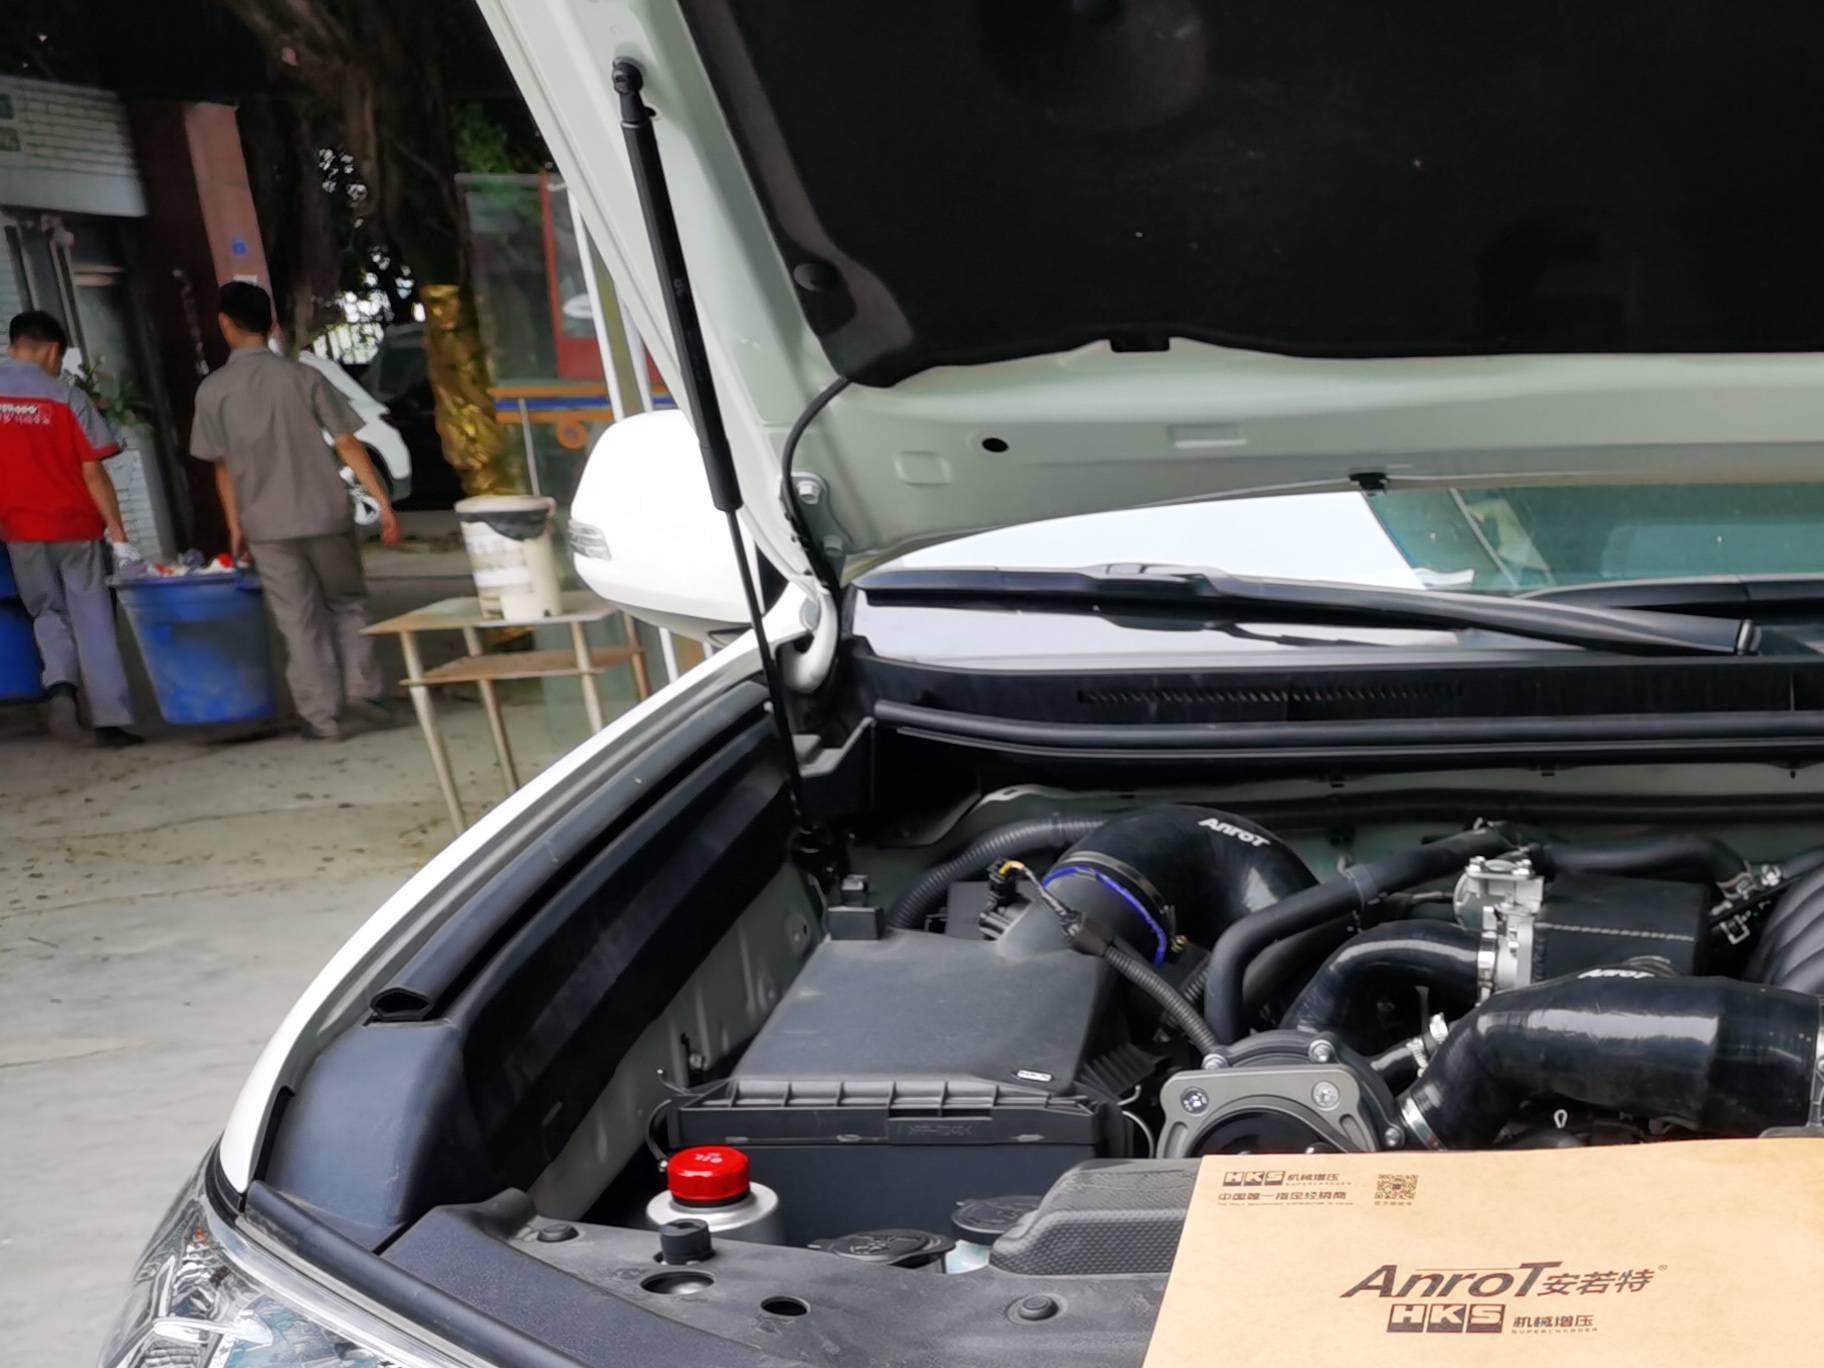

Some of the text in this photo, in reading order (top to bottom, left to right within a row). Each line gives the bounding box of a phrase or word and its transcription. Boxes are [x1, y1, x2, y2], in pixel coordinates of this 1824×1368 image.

[1198, 818, 1271, 847] AnroT
[1222, 1171, 1286, 1186] HKS
[1340, 1261, 1655, 1298] AnroT 安若特
[1387, 1304, 1595, 1333] HKS 机械增压
